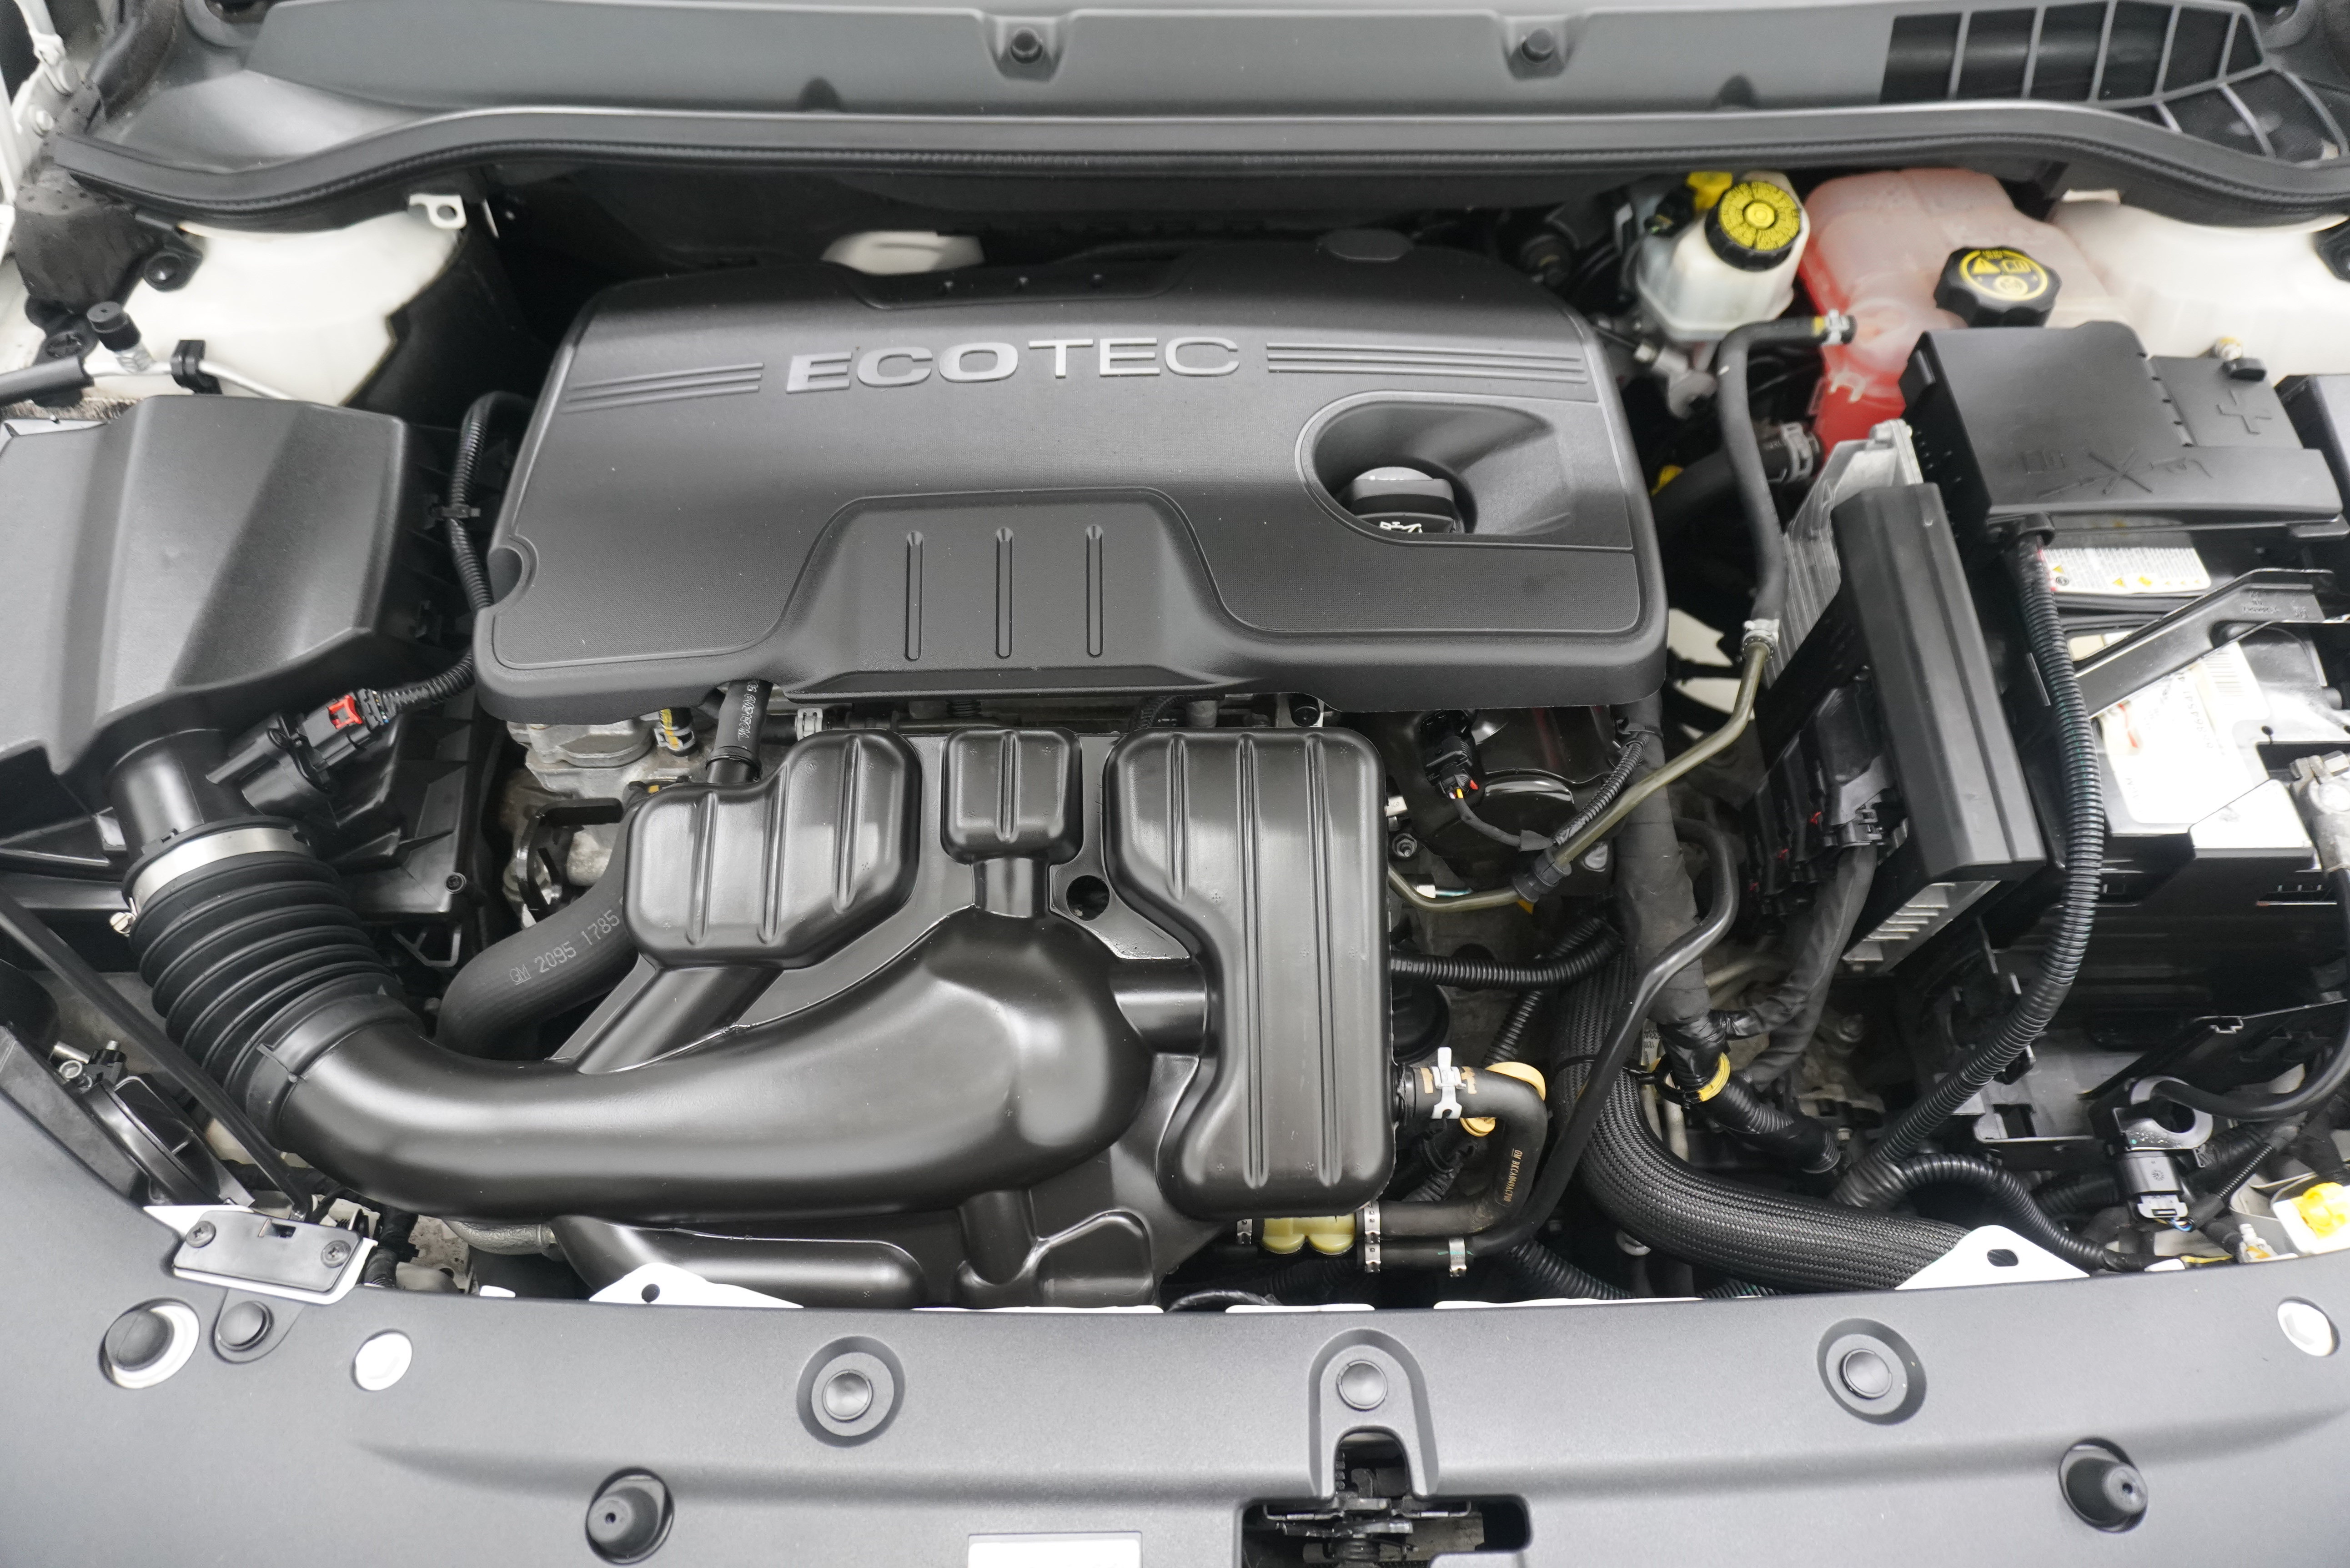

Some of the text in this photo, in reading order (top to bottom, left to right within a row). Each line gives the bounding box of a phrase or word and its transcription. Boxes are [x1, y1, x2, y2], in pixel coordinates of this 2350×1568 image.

[786, 336, 1240, 395] ECOTEC
[509, 909, 620, 985] GM 2095 1785
